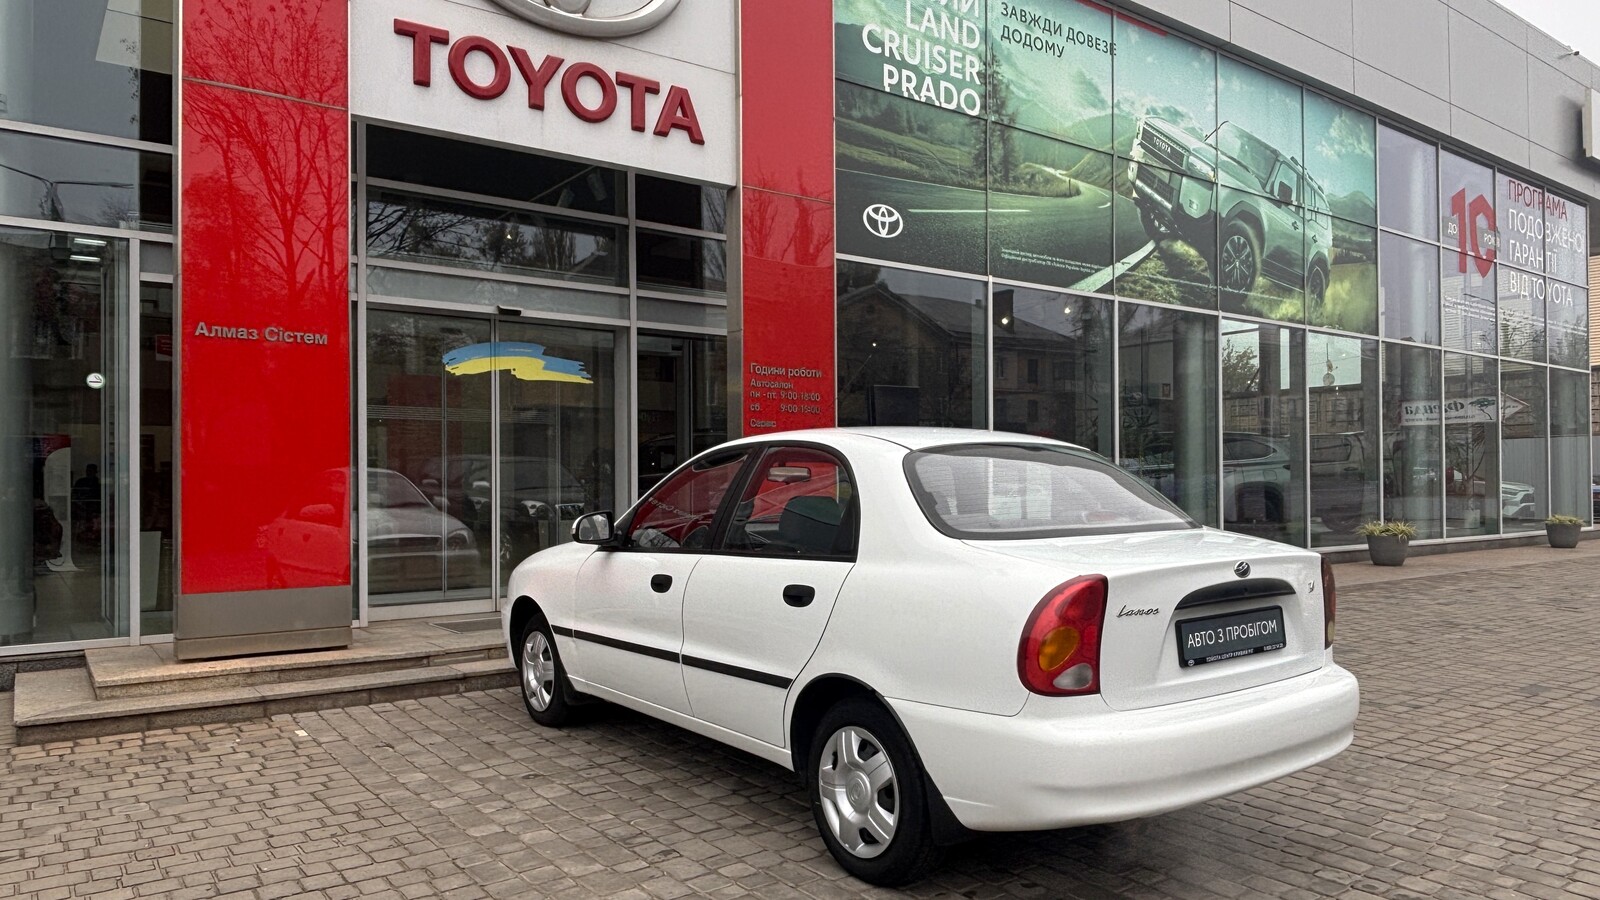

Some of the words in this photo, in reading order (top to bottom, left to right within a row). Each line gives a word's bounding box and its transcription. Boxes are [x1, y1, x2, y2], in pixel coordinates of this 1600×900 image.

[906, 0, 980, 49] LAND
[1000, 2, 1062, 37] ЗАВЖДИ
[1066, 27, 1117, 56] ДОВЕЗЕ
[1000, 24, 1065, 58] ДОДОМУ
[862, 23, 981, 85] CRUISER
[393, 18, 705, 145] TOYOTA
[883, 63, 981, 116] PRADO
[1153, 136, 1171, 154] TOYOTA
[1508, 179, 1568, 222] ПРОГРАМА
[1509, 239, 1558, 274] ГАРАНТІЇ
[1510, 271, 1530, 301] ВІД
[1531, 277, 1573, 307] TOYOTA
[194, 321, 259, 340] Алмаз
[264, 326, 328, 345] Сістем
[750, 362, 786, 377] Години
[788, 367, 822, 379] роботи
[750, 378, 793, 389] Автосалон
[1116, 604, 1160, 619] Lanos
[1187, 630, 1216, 649] АВТО
[1226, 619, 1278, 642] ПРОБІГОМ
